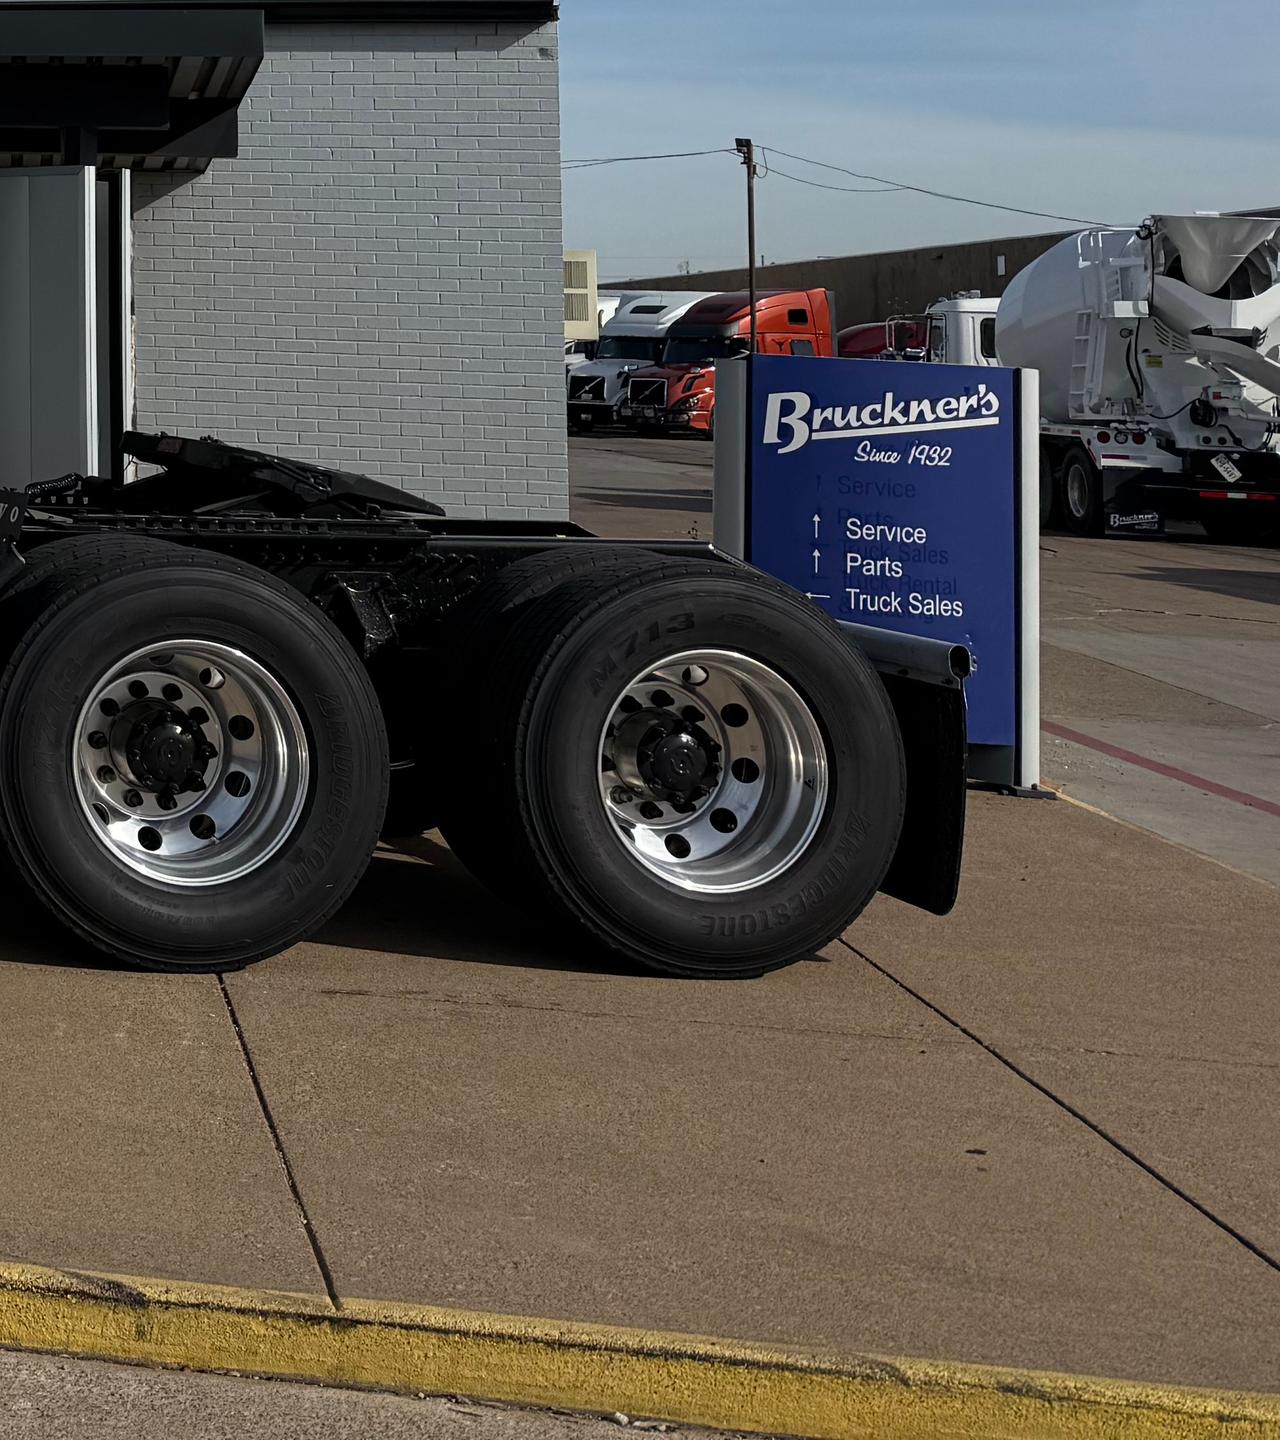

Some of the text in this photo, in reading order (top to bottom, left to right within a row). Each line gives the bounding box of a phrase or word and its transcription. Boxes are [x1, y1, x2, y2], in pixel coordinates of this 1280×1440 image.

[763, 383, 1000, 454] Bruckner's
[854, 439, 953, 466] Since 1932
[837, 475, 917, 499] Service
[846, 517, 927, 544] Service
[846, 552, 903, 578] Parts
[845, 587, 903, 614] Truck
[908, 591, 964, 618] Sales
